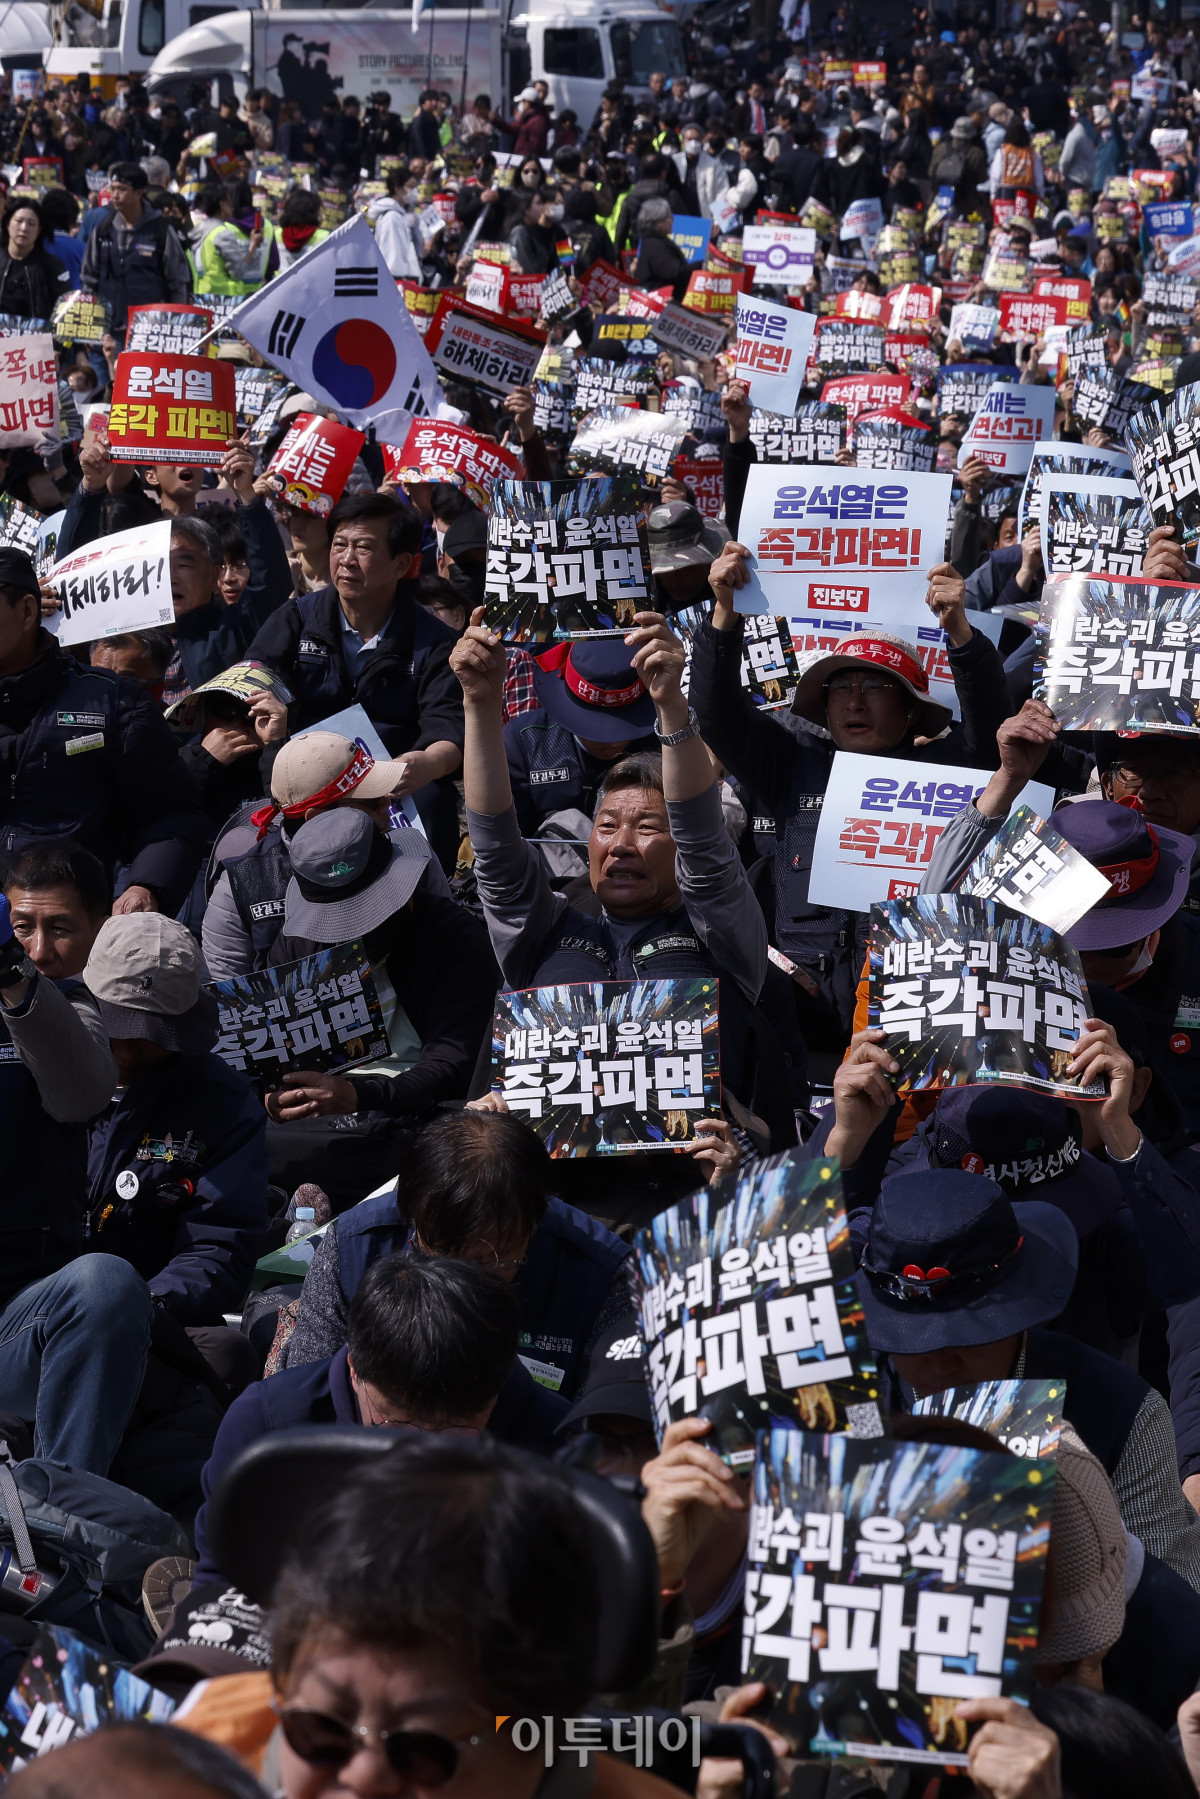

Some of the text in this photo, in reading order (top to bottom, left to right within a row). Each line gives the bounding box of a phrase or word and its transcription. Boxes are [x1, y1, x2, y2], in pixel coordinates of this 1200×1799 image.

[358, 54, 387, 68] STORY
[388, 54, 430, 68] PICTURES
[693, 276, 732, 294] 윤석열
[1038, 282, 1080, 300] 윤석열
[451, 324, 492, 349] 내란동조
[443, 338, 530, 387] 해체하라
[736, 339, 793, 373] 파면!
[818, 345, 883, 364] 즉각파면
[128, 366, 214, 402] 윤석열
[577, 372, 613, 390] 내란수괴
[825, 384, 903, 404] 윤석열 파면
[0, 392, 54, 432] 파면
[980, 391, 1026, 414] 재는
[109, 404, 159, 438] 즉각
[166, 405, 234, 441] 파면!
[533, 407, 571, 433] 즉각
[749, 416, 841, 434] 내란수괴 윤석열
[970, 416, 1043, 441] 면선고!
[281, 428, 335, 465] 봄에는
[414, 429, 479, 460] 윤석열
[478, 449, 516, 480] 파면
[580, 437, 671, 478] 즉각파면
[749, 433, 841, 462] 즉각파면
[856, 435, 902, 450] 내란수괴
[418, 448, 463, 469] 빛의
[855, 449, 933, 472] 즉각파면
[772, 484, 909, 520] 윤석열은
[489, 515, 640, 547] 내란수괴 윤석열
[1053, 520, 1119, 547] 내란수괴
[757, 527, 922, 567] 즉각파면!
[485, 546, 648, 604] 즉각파면
[813, 587, 864, 608] 진보당
[1049, 616, 1156, 645] 내란수괴
[866, 643, 903, 667] 투쟁
[1041, 646, 1200, 699] 즉각파
[578, 680, 600, 702] 단결
[530, 769, 568, 784] 단결투쟁
[860, 777, 986, 819] 윤석열
[1111, 869, 1131, 894] 쟁
[883, 938, 1084, 1002] 내란수괴 윤석열
[219, 970, 363, 1032] 란수괴 윤석열
[879, 972, 1092, 1053] 즉각파면
[210, 993, 374, 1071] 즉각파면
[504, 1018, 703, 1060] 내란수괴 윤석열
[501, 1053, 705, 1118] 즉각파면
[718, 1226, 833, 1299] 윤석열
[749, 1503, 1019, 1591] 란수괴 윤석열
